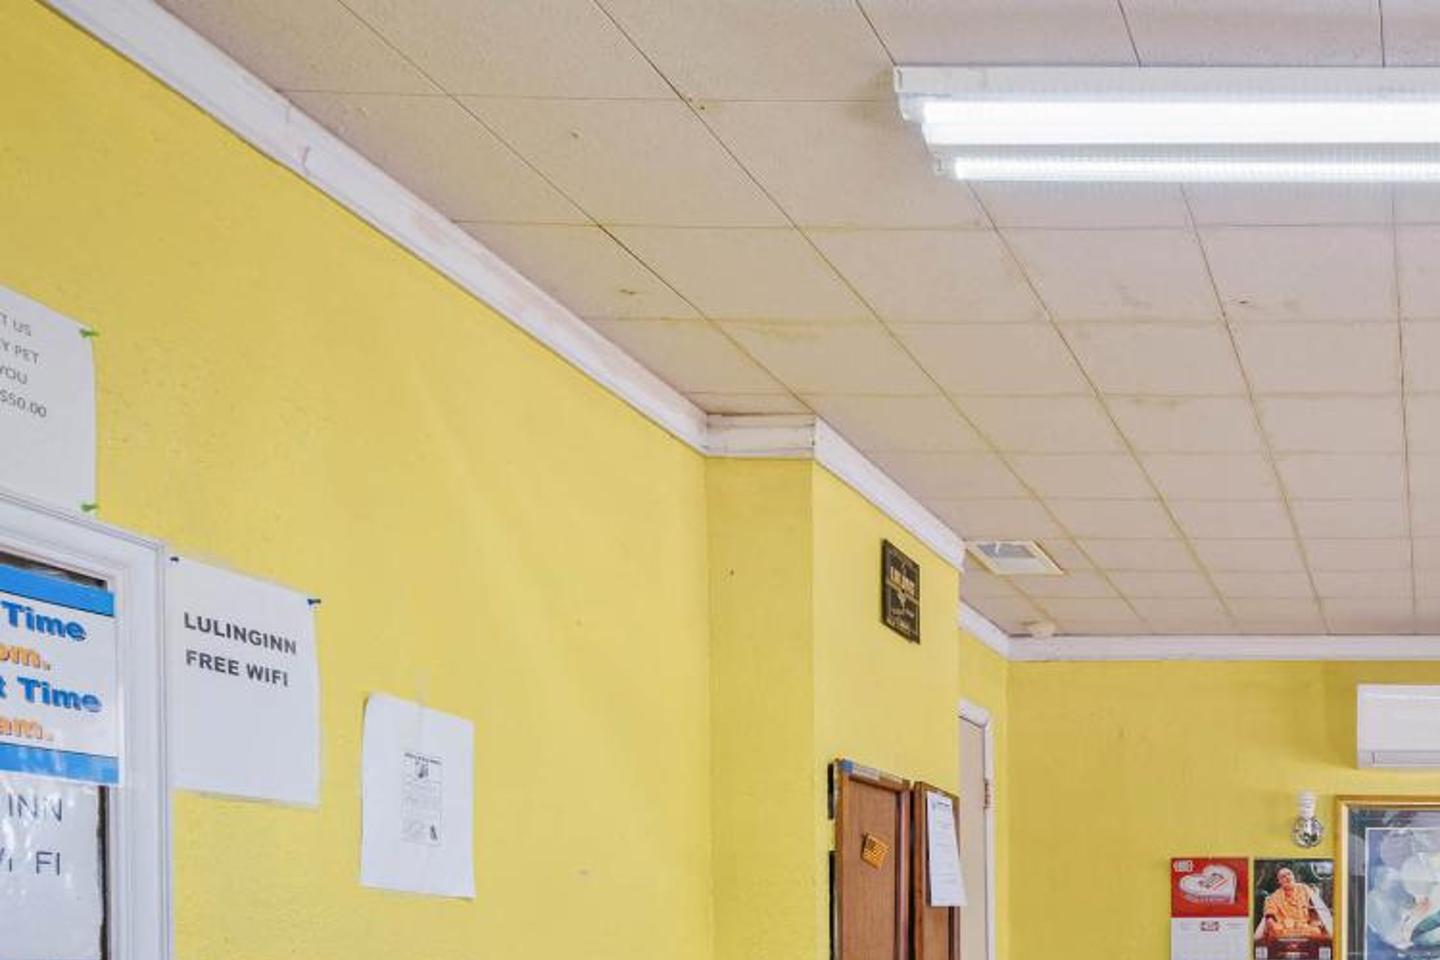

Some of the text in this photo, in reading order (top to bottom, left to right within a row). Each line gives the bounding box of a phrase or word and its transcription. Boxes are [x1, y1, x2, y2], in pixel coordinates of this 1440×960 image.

[13, 319, 32, 337] US
[14, 344, 39, 364] PET
[2, 600, 87, 641] Time
[184, 612, 297, 655] LULINGINN
[186, 650, 288, 687] FREE WIFI
[17, 676, 102, 712] Time
[36, 851, 60, 876] FI
